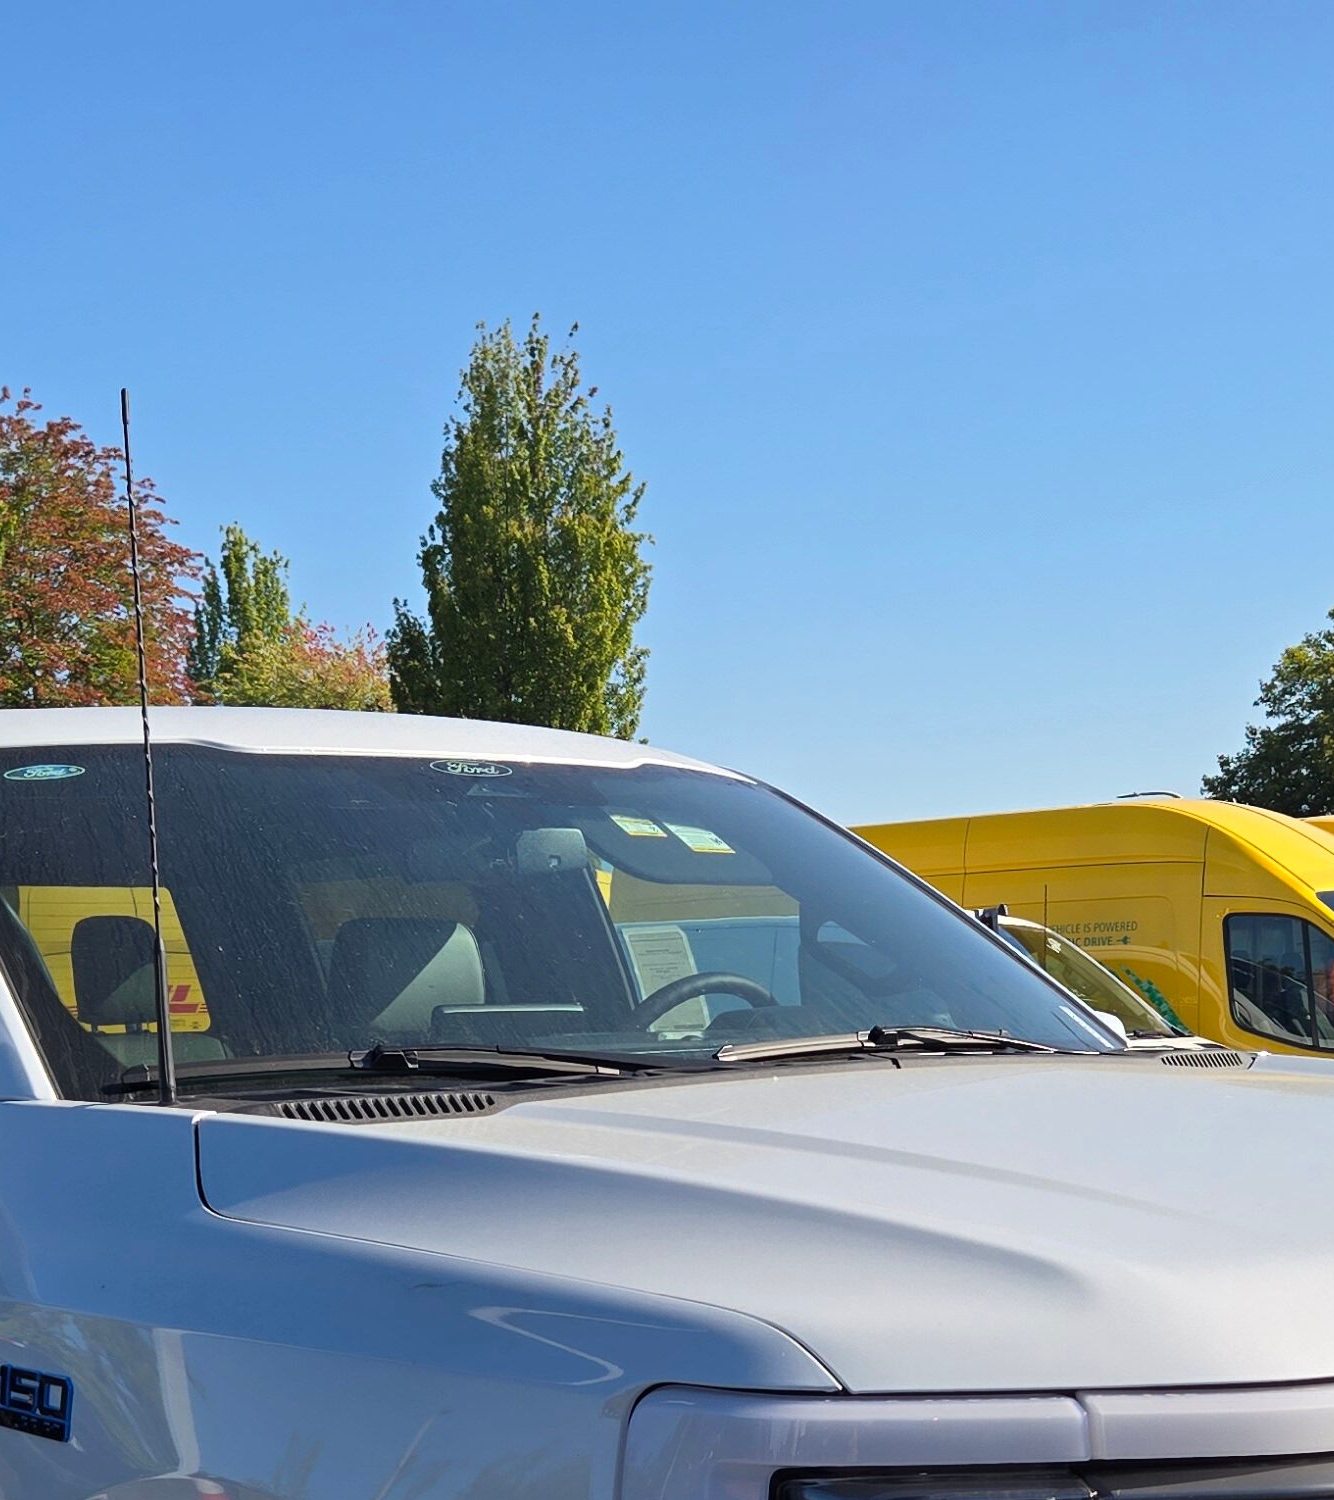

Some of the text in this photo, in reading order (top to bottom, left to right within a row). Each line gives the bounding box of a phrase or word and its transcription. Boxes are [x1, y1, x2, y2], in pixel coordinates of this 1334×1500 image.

[446, 761, 500, 775] Ford
[1051, 921, 1138, 934] EHICLE IS POWERED
